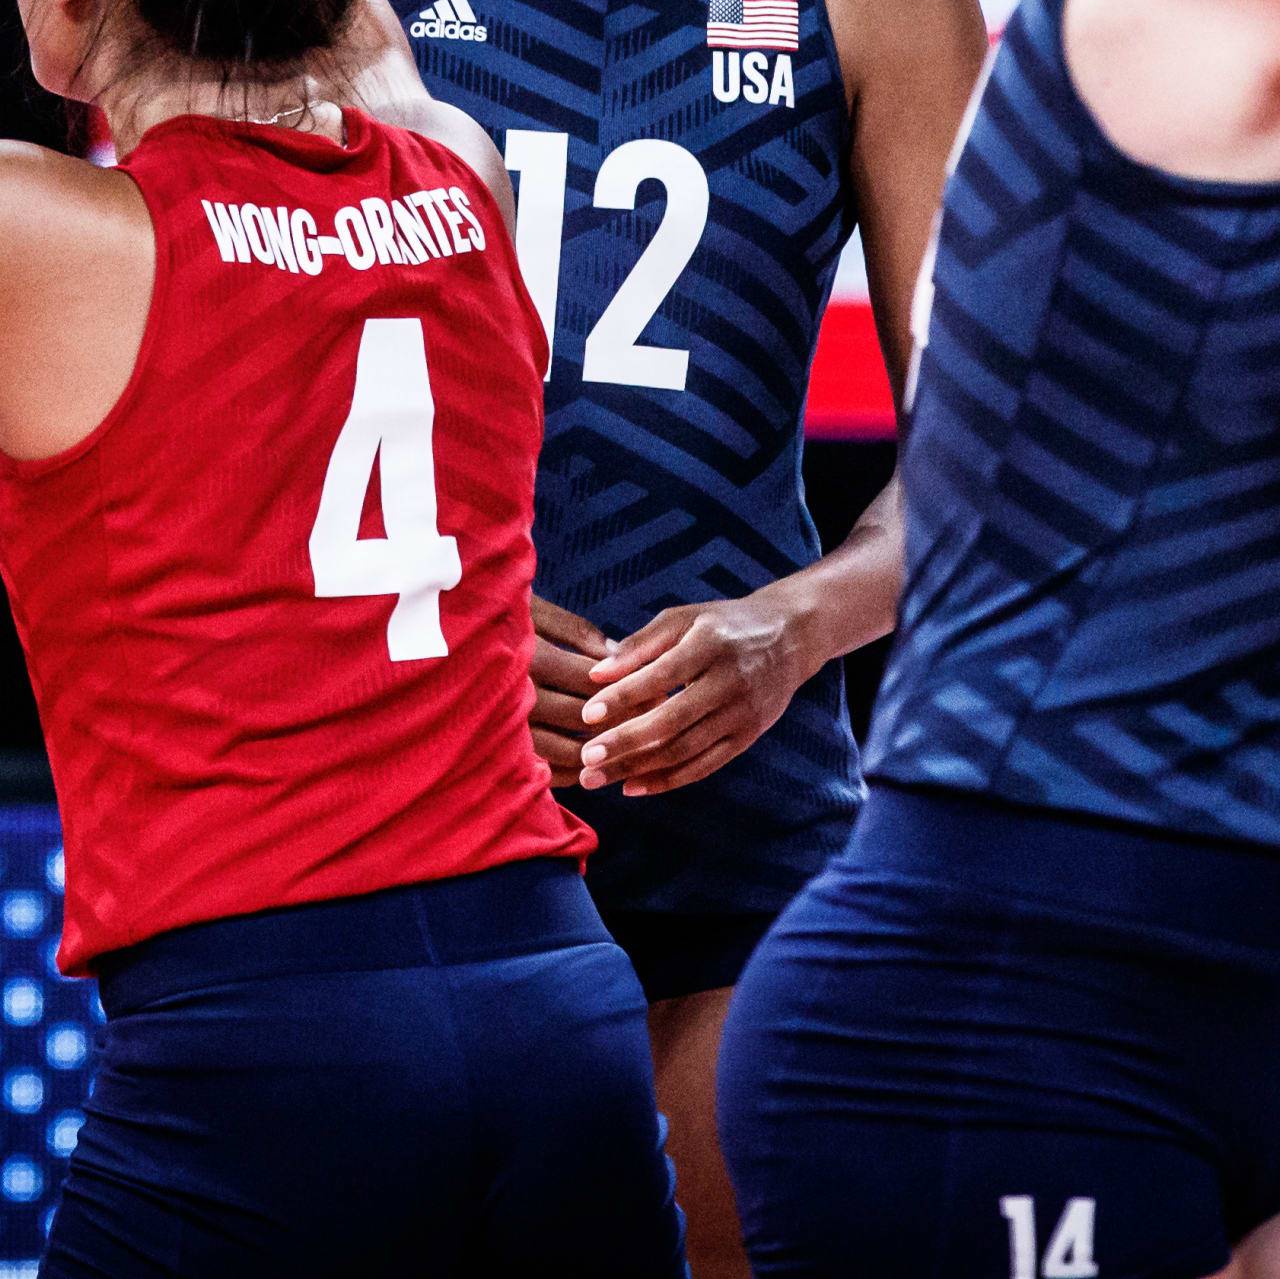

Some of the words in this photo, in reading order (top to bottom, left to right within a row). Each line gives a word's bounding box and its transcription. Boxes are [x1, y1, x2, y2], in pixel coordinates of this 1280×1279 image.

[410, 18, 487, 42] adidas
[712, 51, 795, 108] USA
[201, 186, 486, 276] WONG-ORANTES
[505, 129, 710, 391] 12
[309, 318, 462, 661] 4
[999, 1194, 1100, 1279] 14
